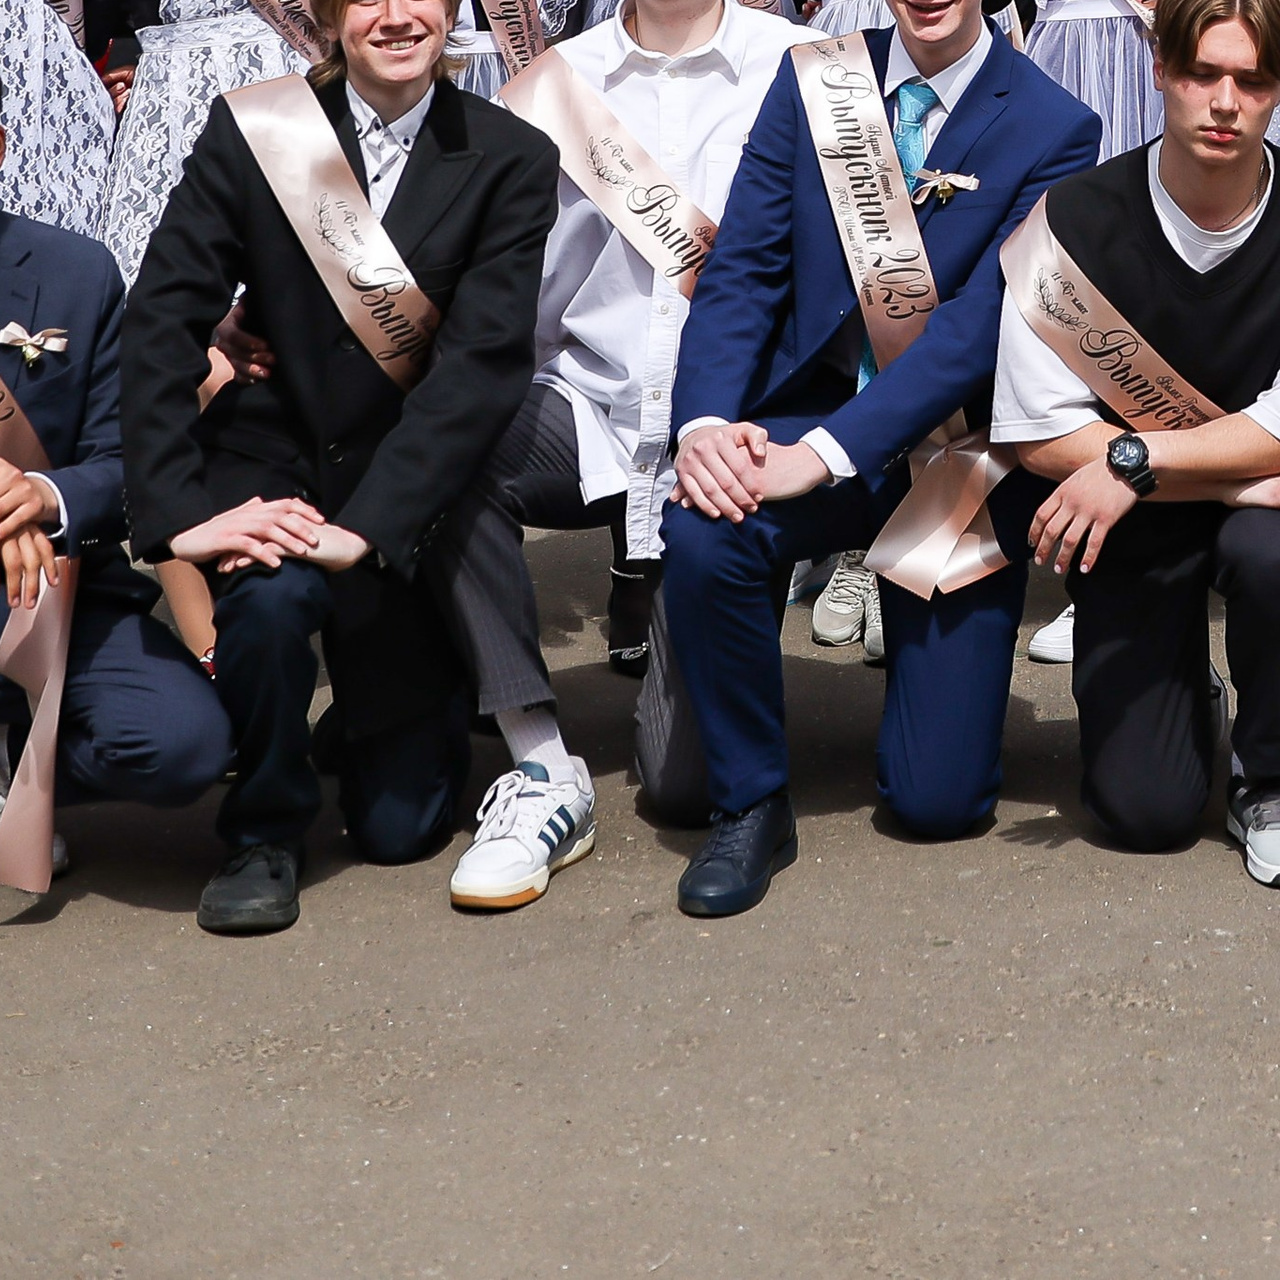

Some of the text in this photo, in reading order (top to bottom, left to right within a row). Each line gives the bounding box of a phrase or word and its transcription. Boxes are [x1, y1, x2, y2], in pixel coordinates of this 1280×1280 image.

[819, 62, 935, 320] Выпускник 2023
[876, 158, 896, 200] Матвей
